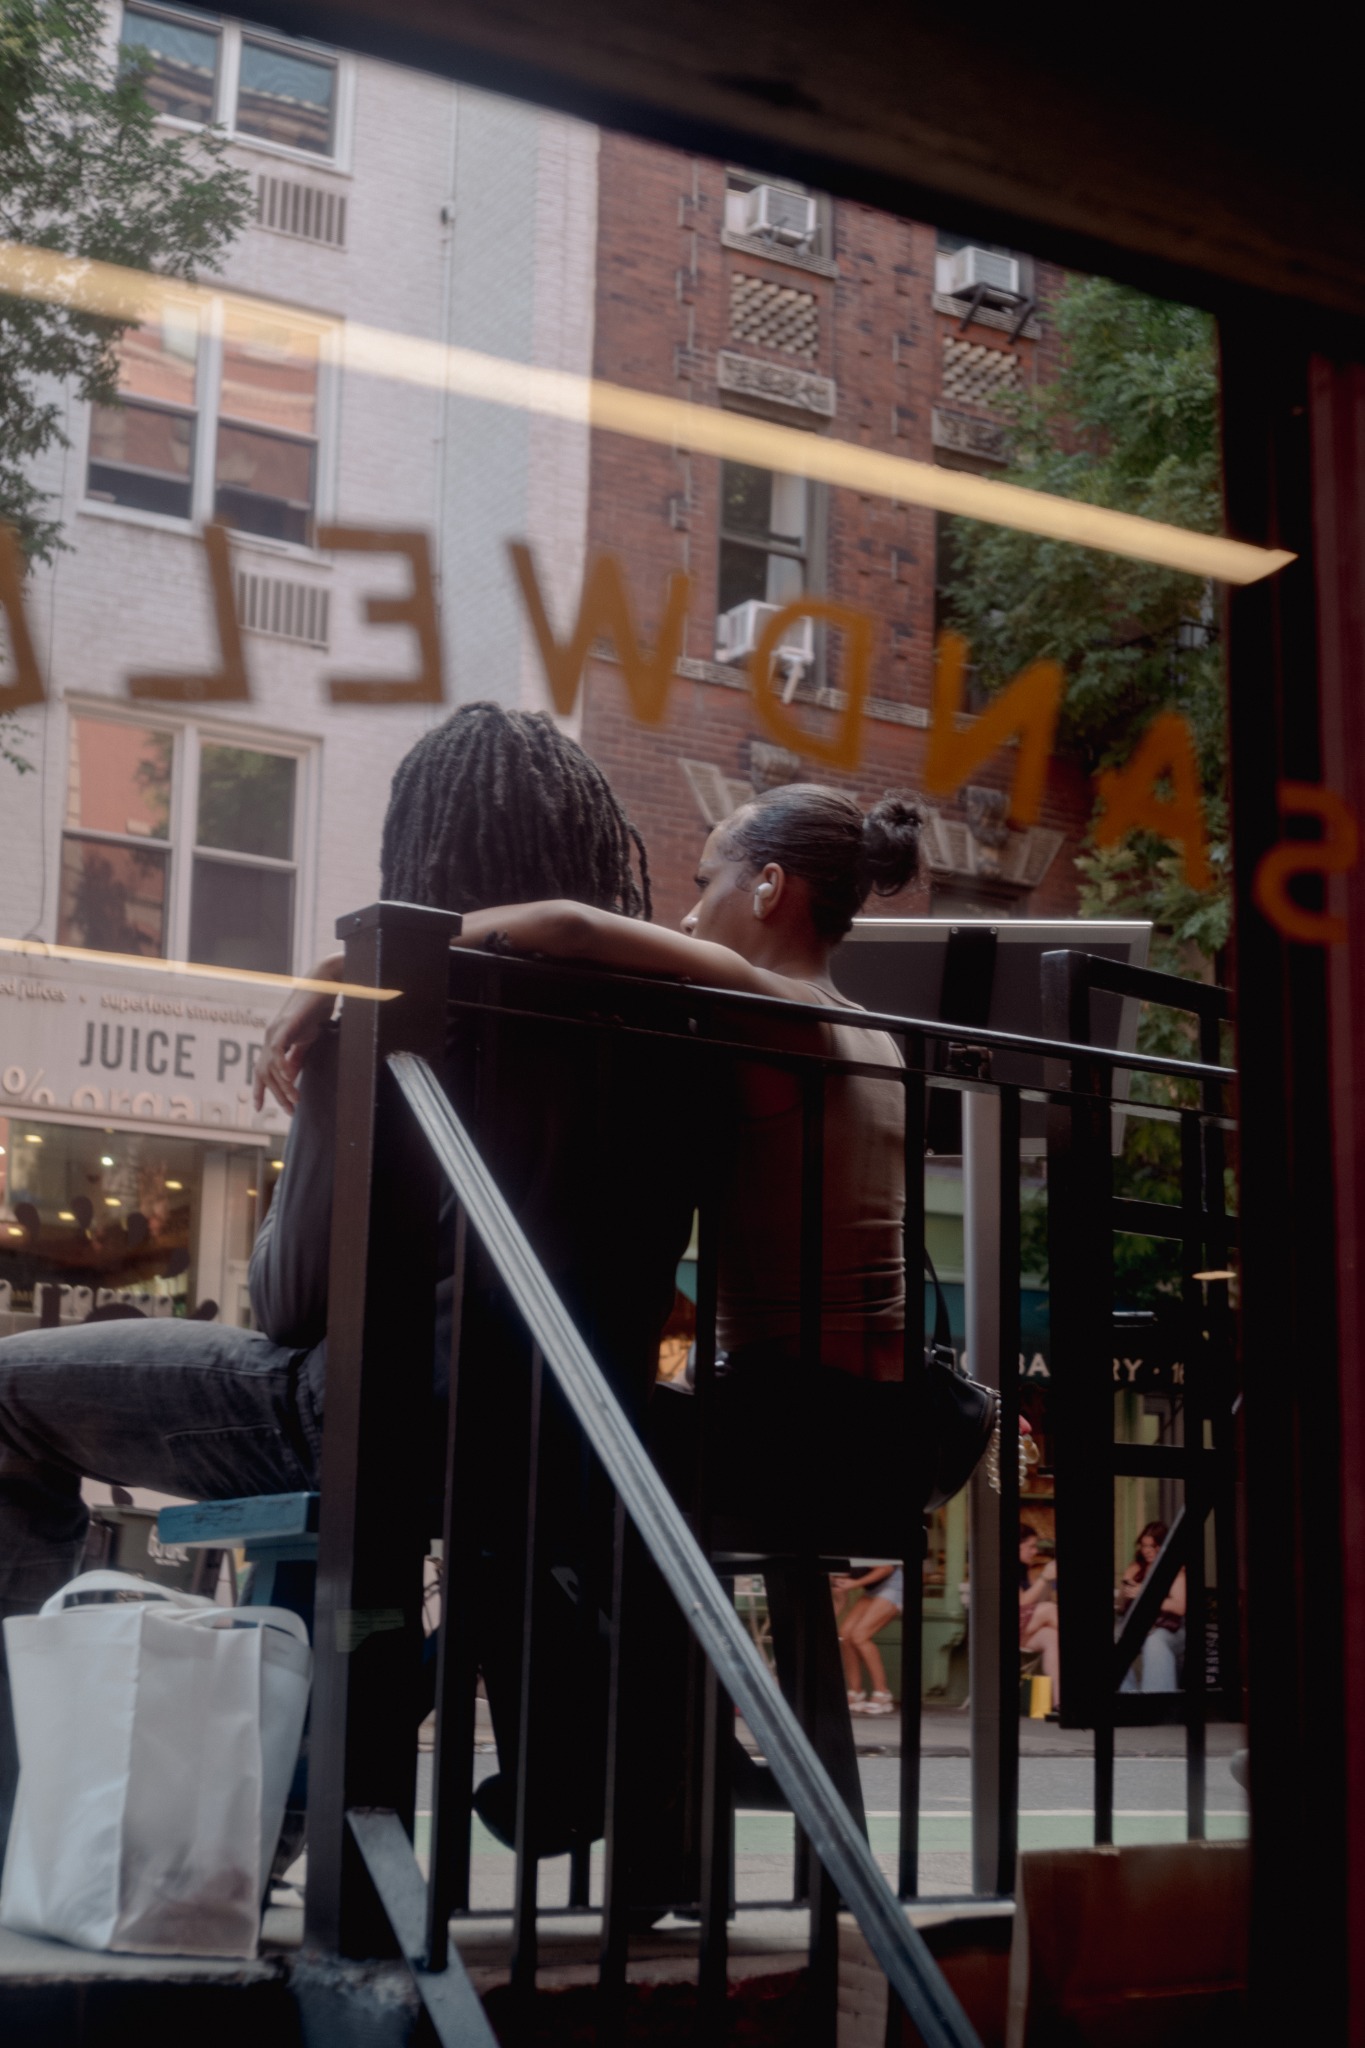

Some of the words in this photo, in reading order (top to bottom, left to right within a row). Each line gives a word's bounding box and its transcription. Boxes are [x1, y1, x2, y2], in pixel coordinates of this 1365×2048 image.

[100, 993, 184, 1017] superfood
[186, 1004, 267, 1028] smoothies
[79, 1020, 196, 1080] JUICE
